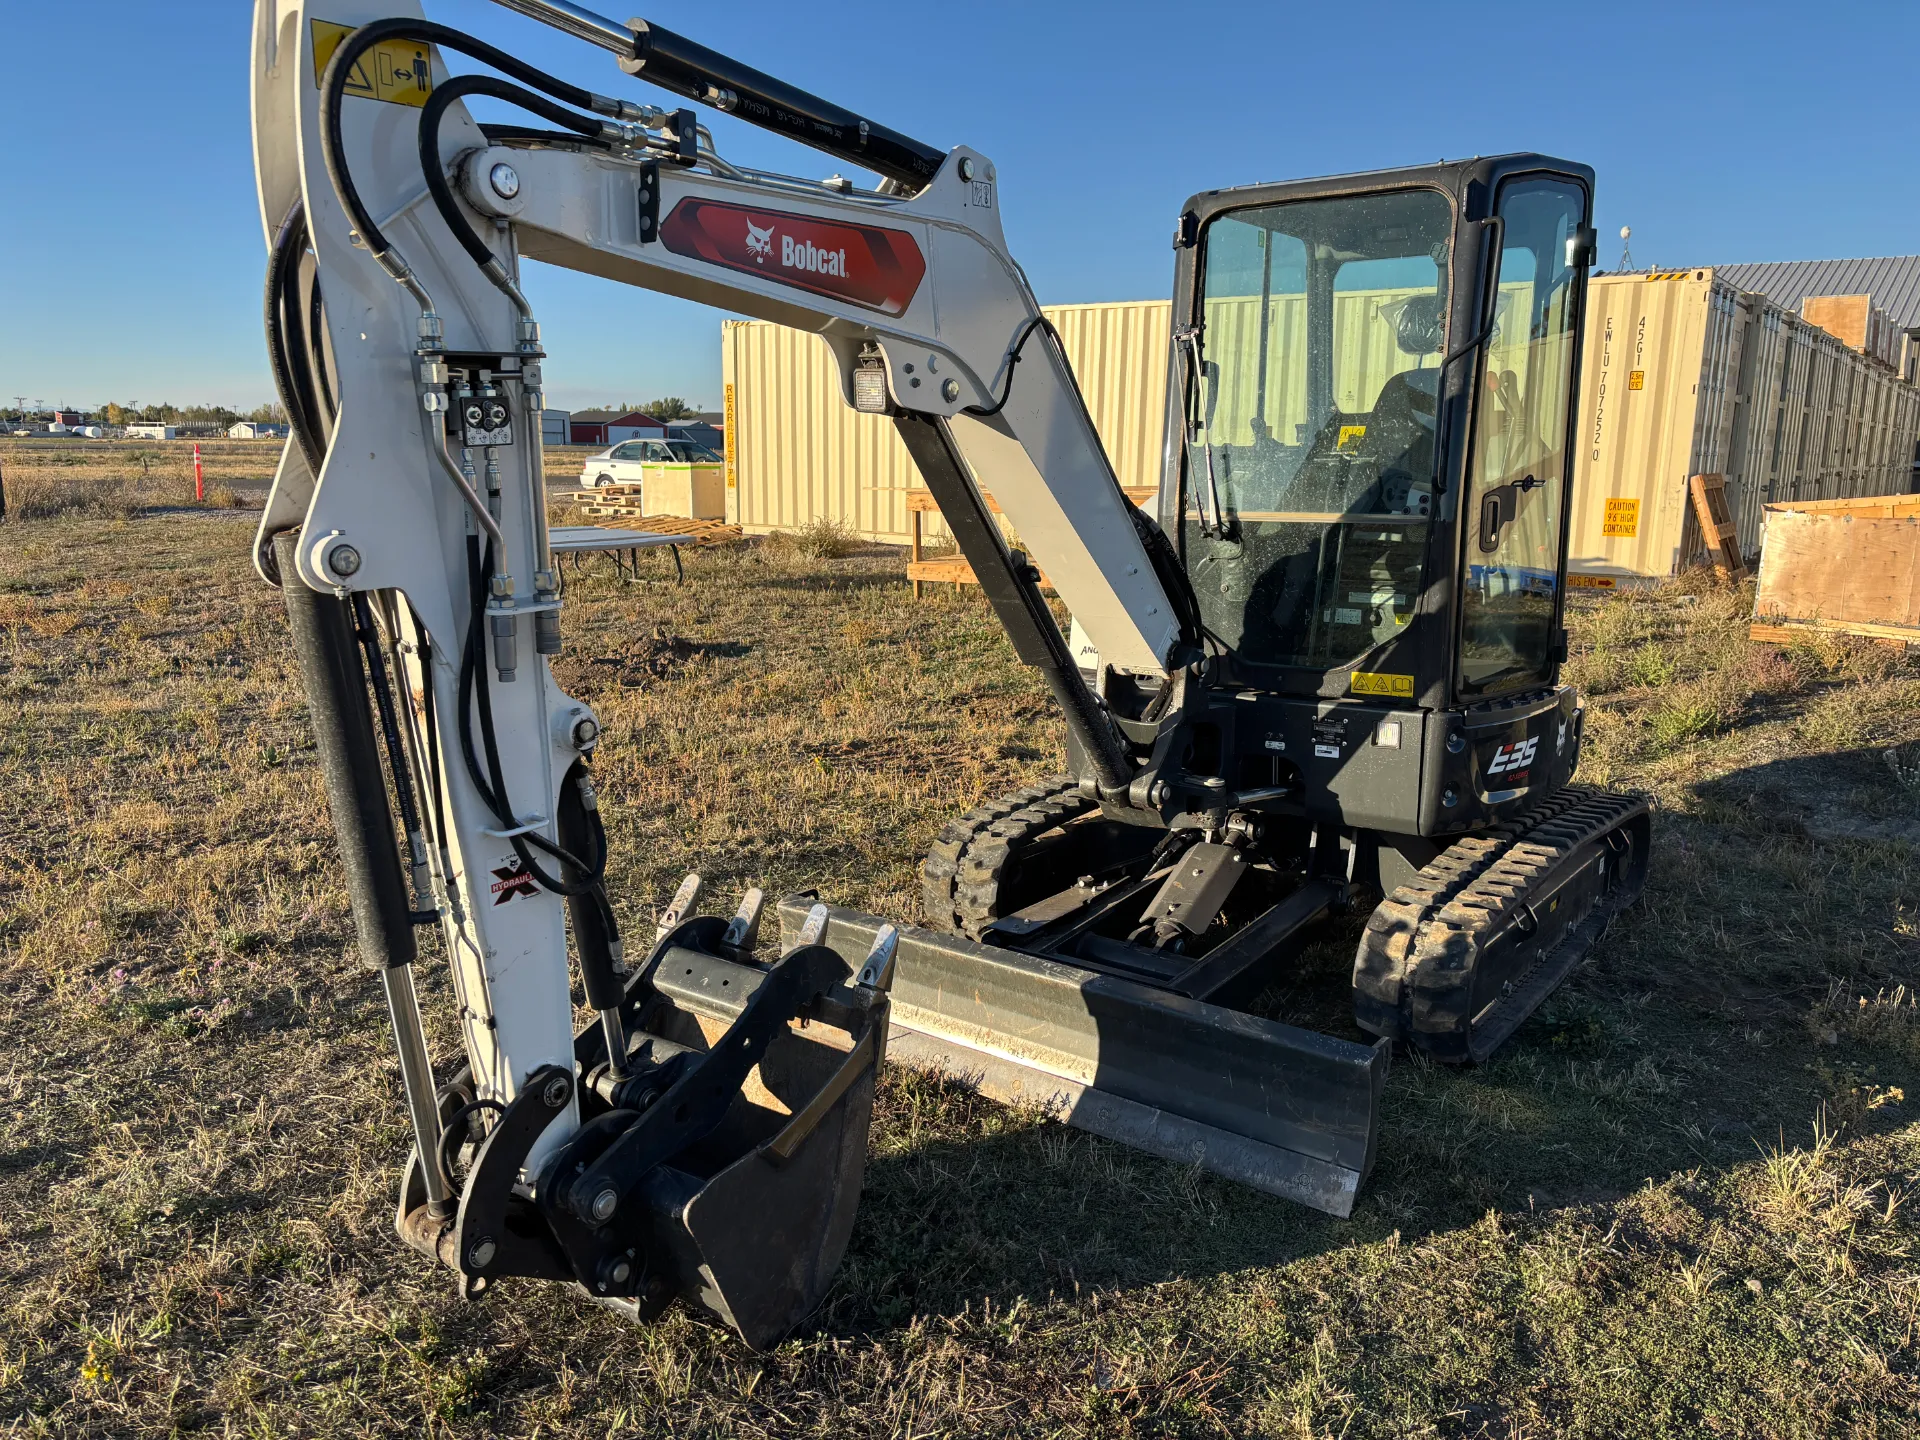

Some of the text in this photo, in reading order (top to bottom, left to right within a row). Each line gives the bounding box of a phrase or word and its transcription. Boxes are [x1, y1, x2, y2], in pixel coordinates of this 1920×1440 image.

[781, 234, 846, 278] Bobcat
[1603, 317, 1613, 367] EWLU
[1636, 316, 1646, 366] 45G1
[726, 384, 734, 421] REAR
[1594, 371, 1608, 444] 707252
[1608, 501, 1636, 511] CAUTION
[1620, 513, 1635, 523] HIGH
[1603, 523, 1636, 534] CONTAINER
[1583, 576, 1597, 588] END
[1487, 736, 1540, 775] E35
[492, 873, 535, 892] HYDRAULI
